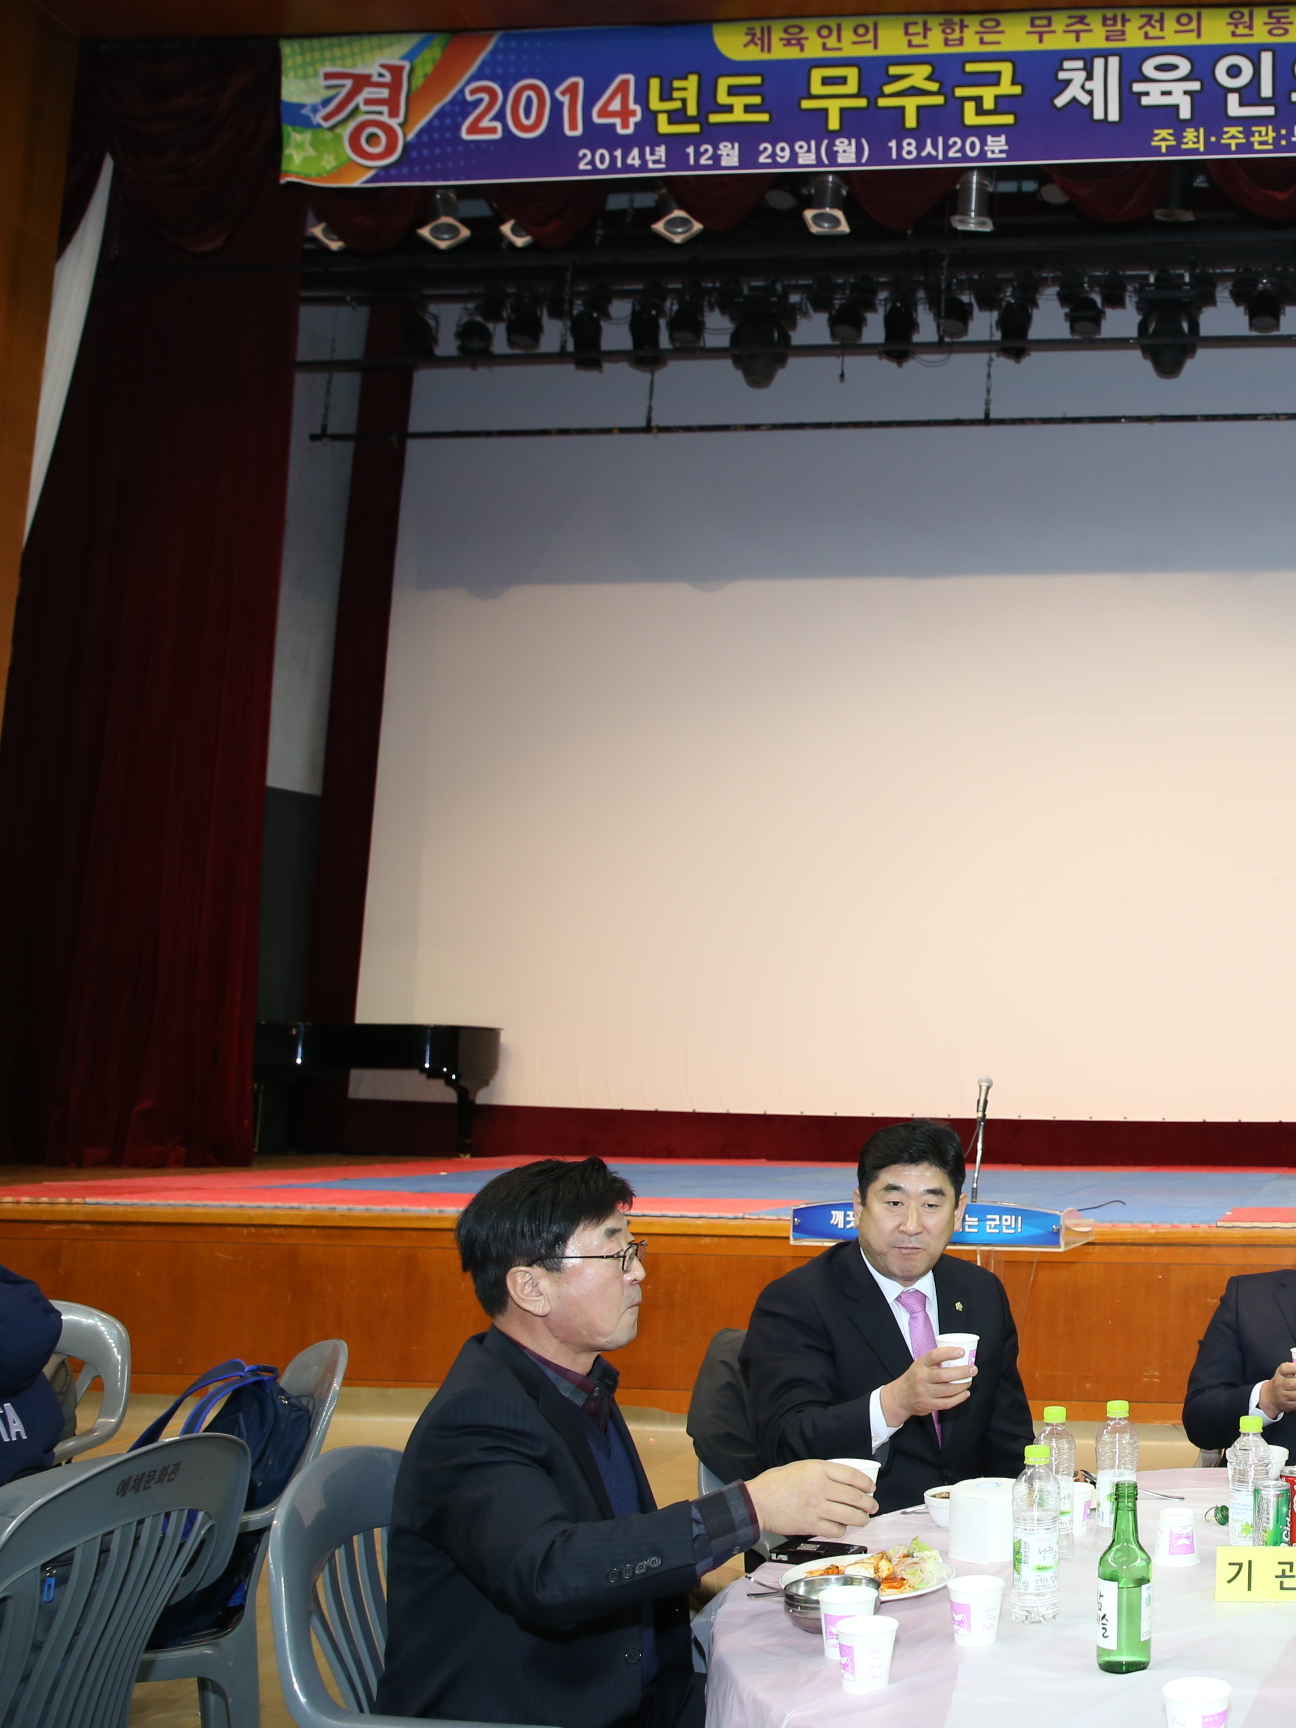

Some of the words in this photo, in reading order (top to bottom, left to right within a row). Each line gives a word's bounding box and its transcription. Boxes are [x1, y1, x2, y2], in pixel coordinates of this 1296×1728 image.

[743, 21, 879, 54] 체육인의
[903, 18, 1006, 49] 단합은
[1025, 10, 1203, 44] 무주발전의
[316, 59, 411, 167] 경
[461, 72, 771, 140] 2014년도
[799, 60, 1023, 132] 무주군
[577, 144, 667, 170] 2014년
[685, 141, 741, 167] 12월
[758, 137, 871, 166] 29일(월)
[887, 134, 1010, 161] 18시20분
[985, 1213, 1023, 1235] 군민!
[1226, 1558, 1253, 1592] 기
